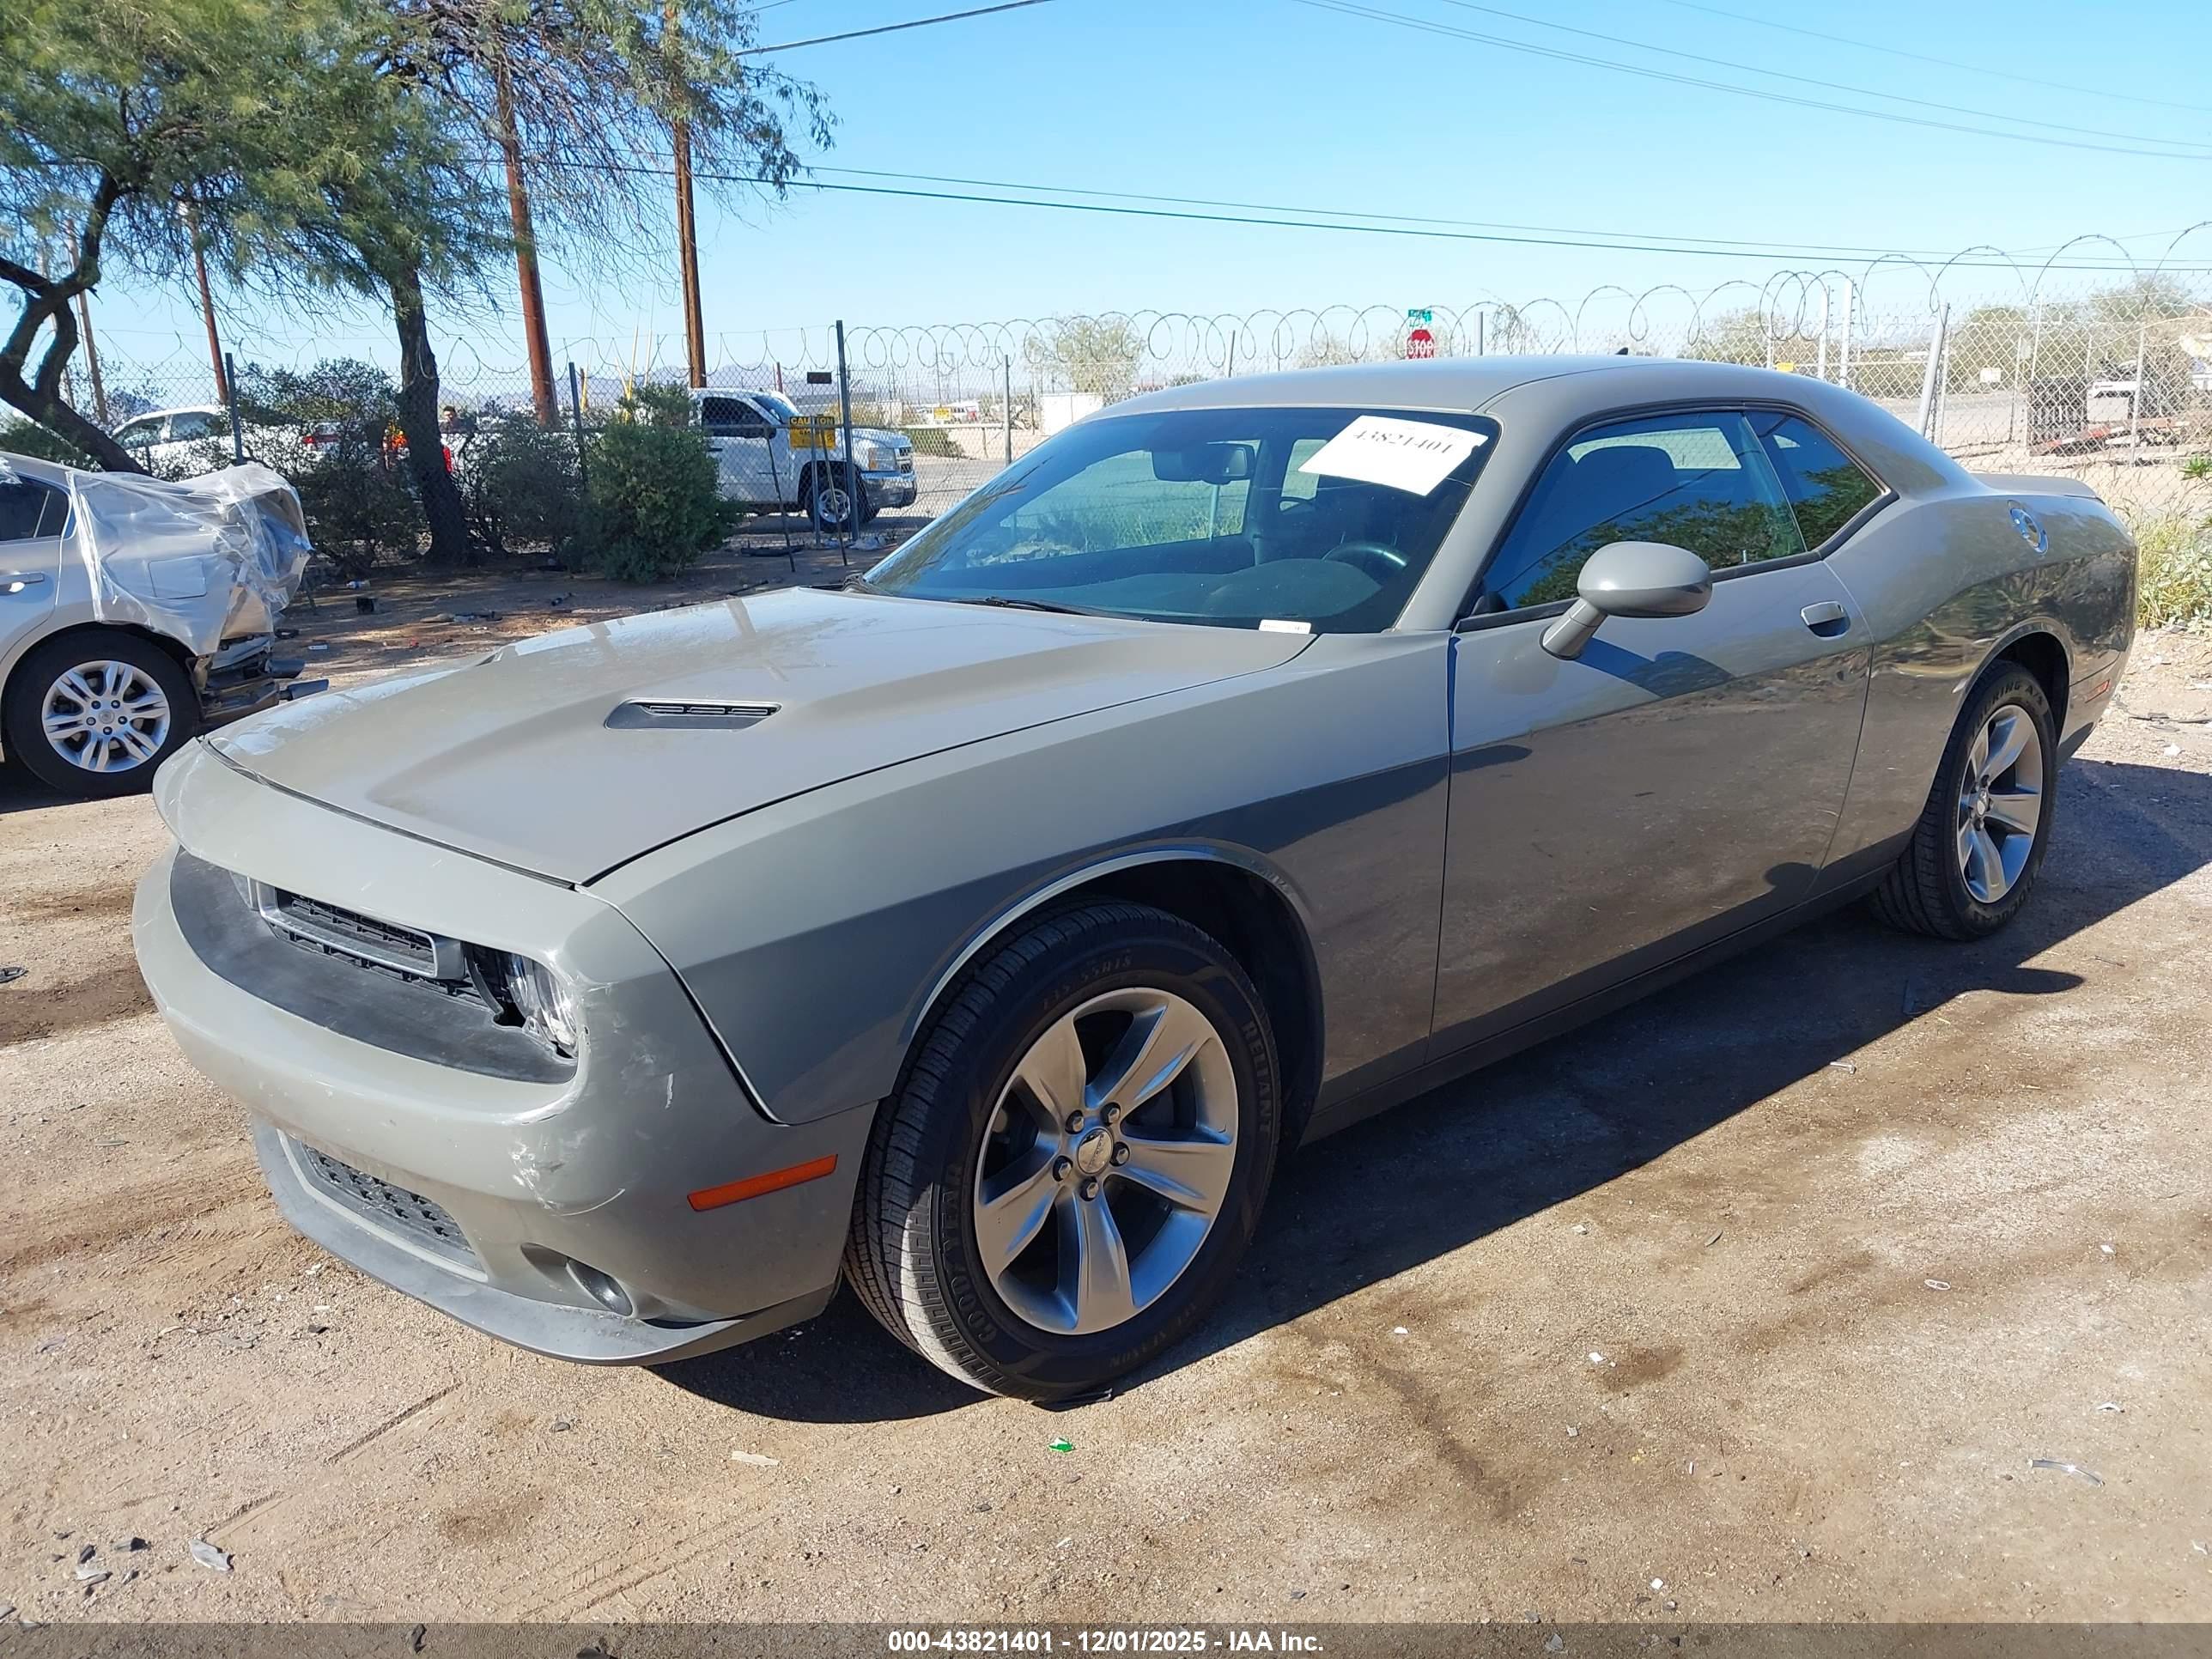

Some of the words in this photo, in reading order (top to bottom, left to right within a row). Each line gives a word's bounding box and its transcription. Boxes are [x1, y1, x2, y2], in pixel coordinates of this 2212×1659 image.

[1408, 339, 1433, 356] STOP
[1242, 1020, 1273, 1139] RELIANT
[941, 1164, 998, 1344] GOODYEAR
